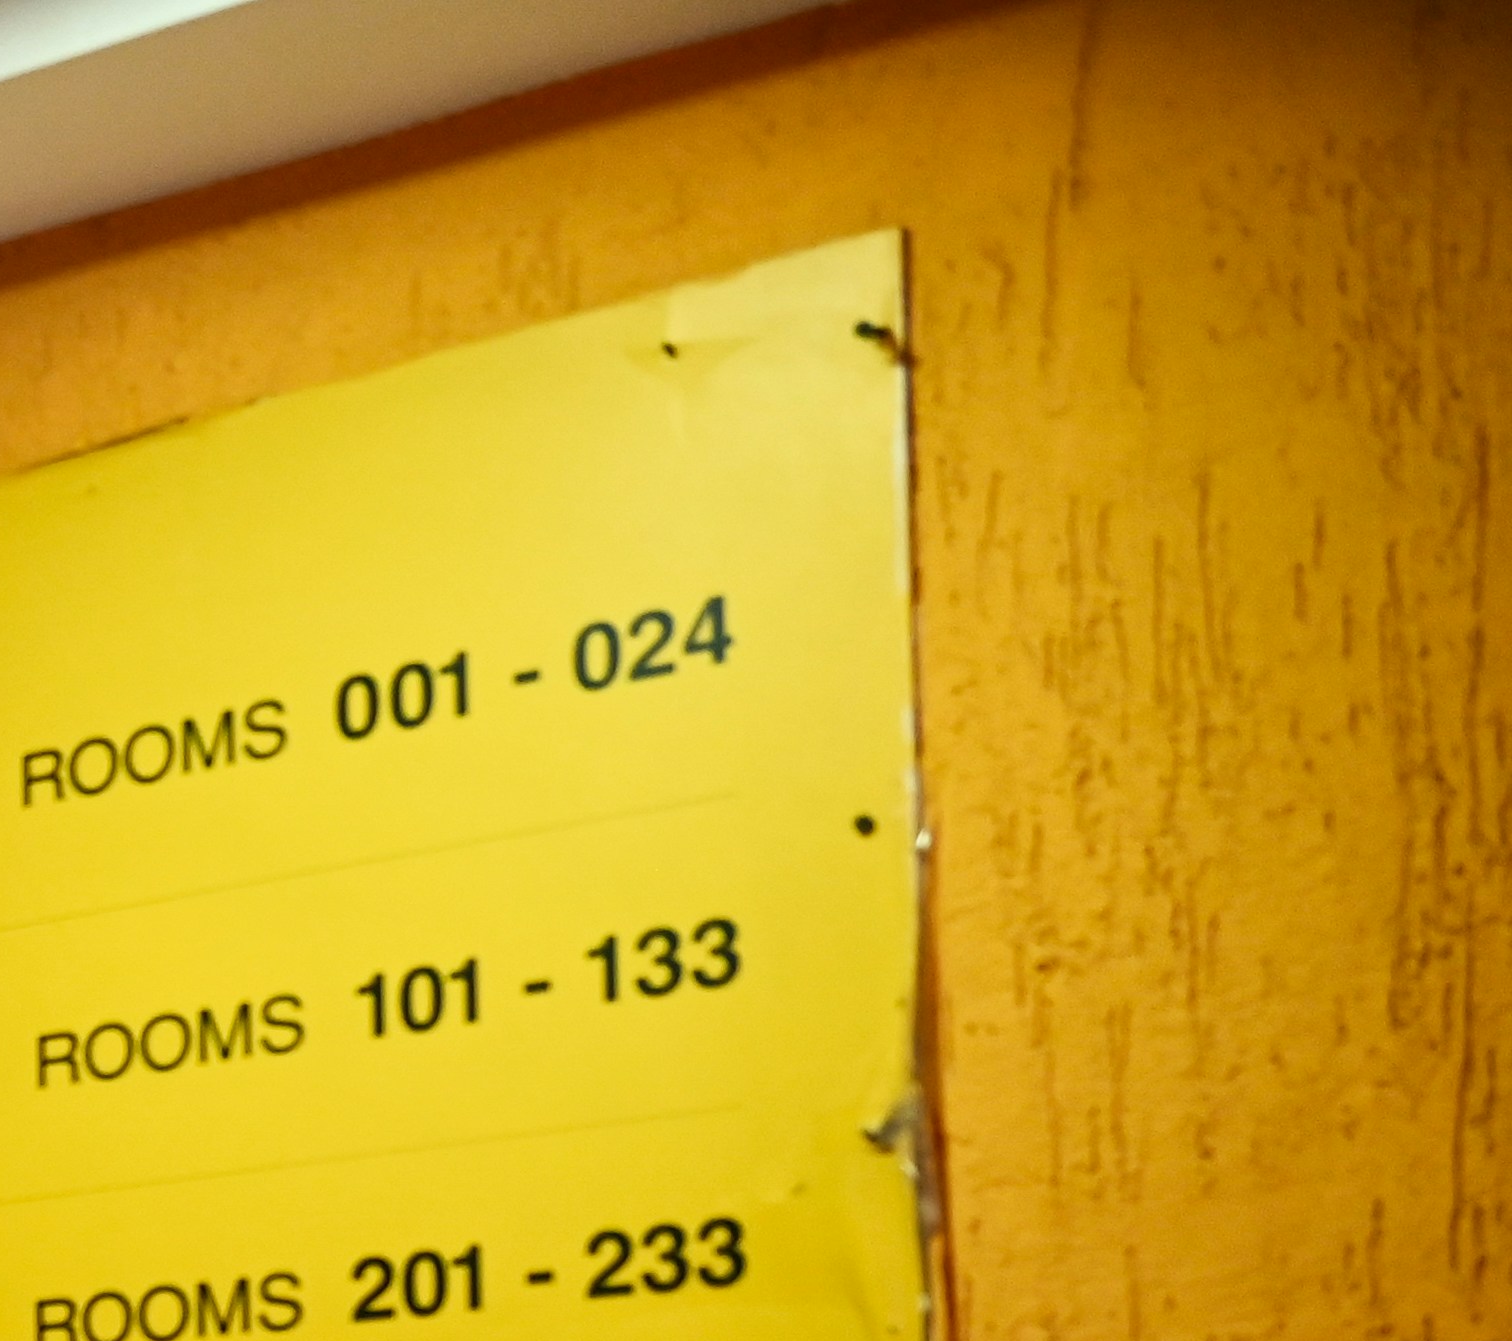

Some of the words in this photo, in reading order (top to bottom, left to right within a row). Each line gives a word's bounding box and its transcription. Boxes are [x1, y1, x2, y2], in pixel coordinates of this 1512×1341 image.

[22, 700, 289, 807] ROOMS
[335, 650, 470, 740] 001
[513, 668, 541, 686] -
[573, 596, 734, 692] 024
[37, 995, 305, 1088] ROOMS
[358, 957, 480, 1038] 101
[522, 978, 551, 995] -
[587, 917, 742, 1004] 133
[351, 1244, 482, 1323] 201
[527, 1268, 555, 1285] -
[584, 1217, 747, 1299] 233
